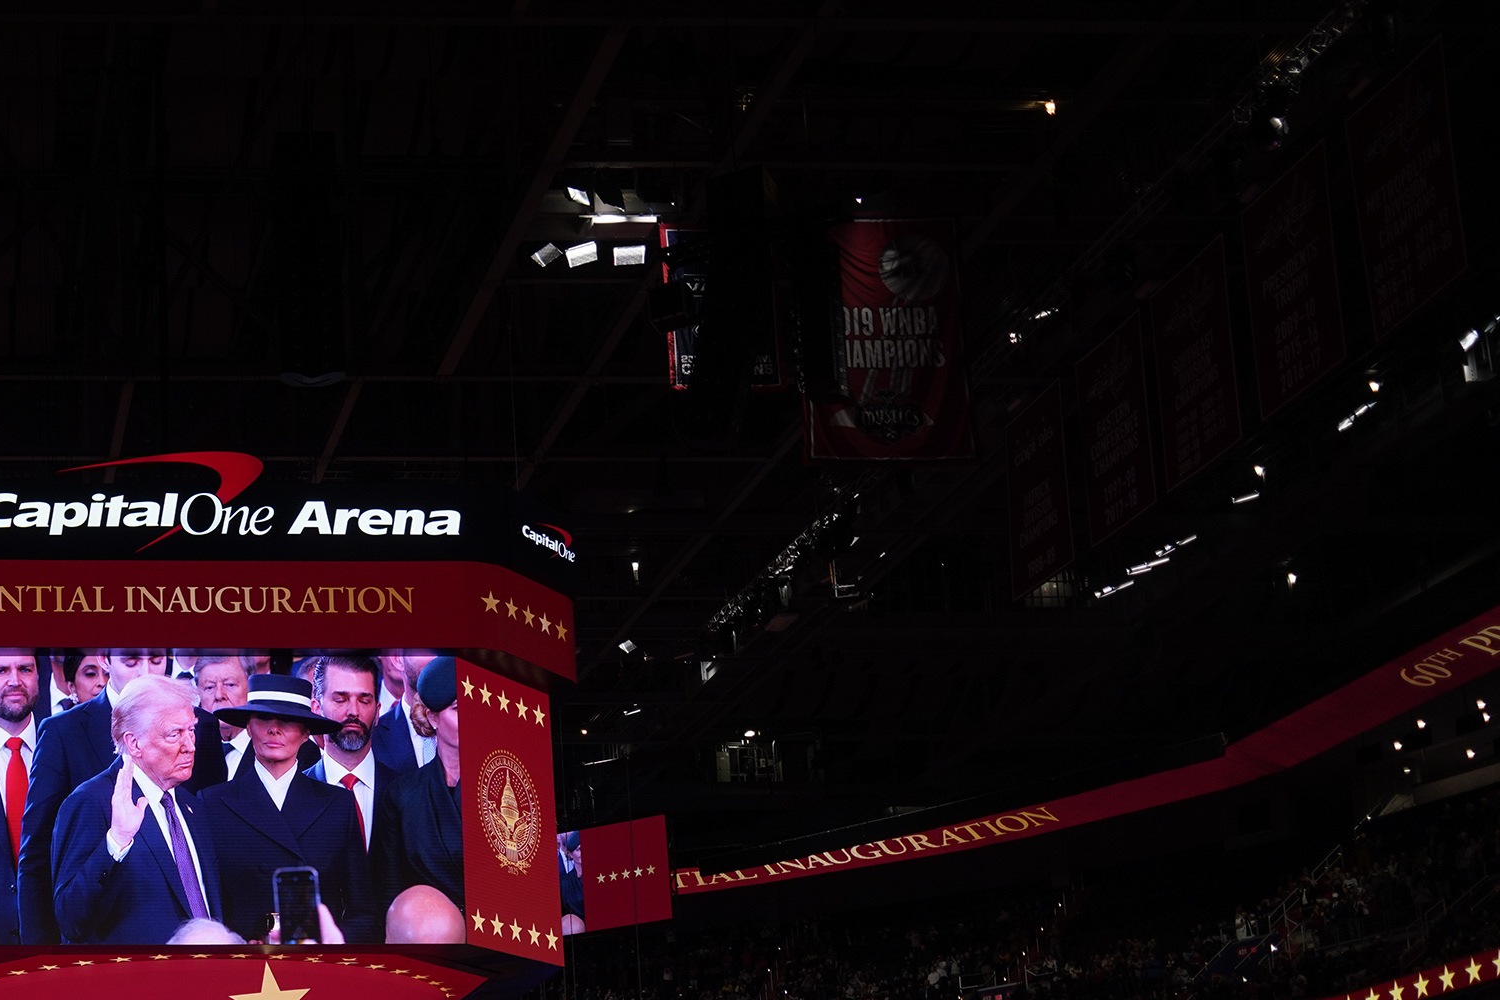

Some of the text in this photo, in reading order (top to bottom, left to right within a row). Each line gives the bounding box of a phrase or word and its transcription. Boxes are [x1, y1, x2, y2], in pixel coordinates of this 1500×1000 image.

[1274, 269, 1310, 311] TROPHY
[879, 306, 939, 336] WNBA
[1175, 363, 1219, 411] CHAMPIONS
[1090, 409, 1139, 461] CONFERENCE
[1096, 400, 1130, 438] EASTERN
[1094, 431, 1139, 479] CHAMPIONS
[287, 500, 461, 537] Arena
[1020, 508, 1059, 549] CHAMPIONS
[1023, 495, 1053, 529] DIVISION
[123, 585, 415, 614] INAUGURATION
[1400, 648, 1464, 686] 60TH
[764, 806, 1059, 877] INAUGURATION
